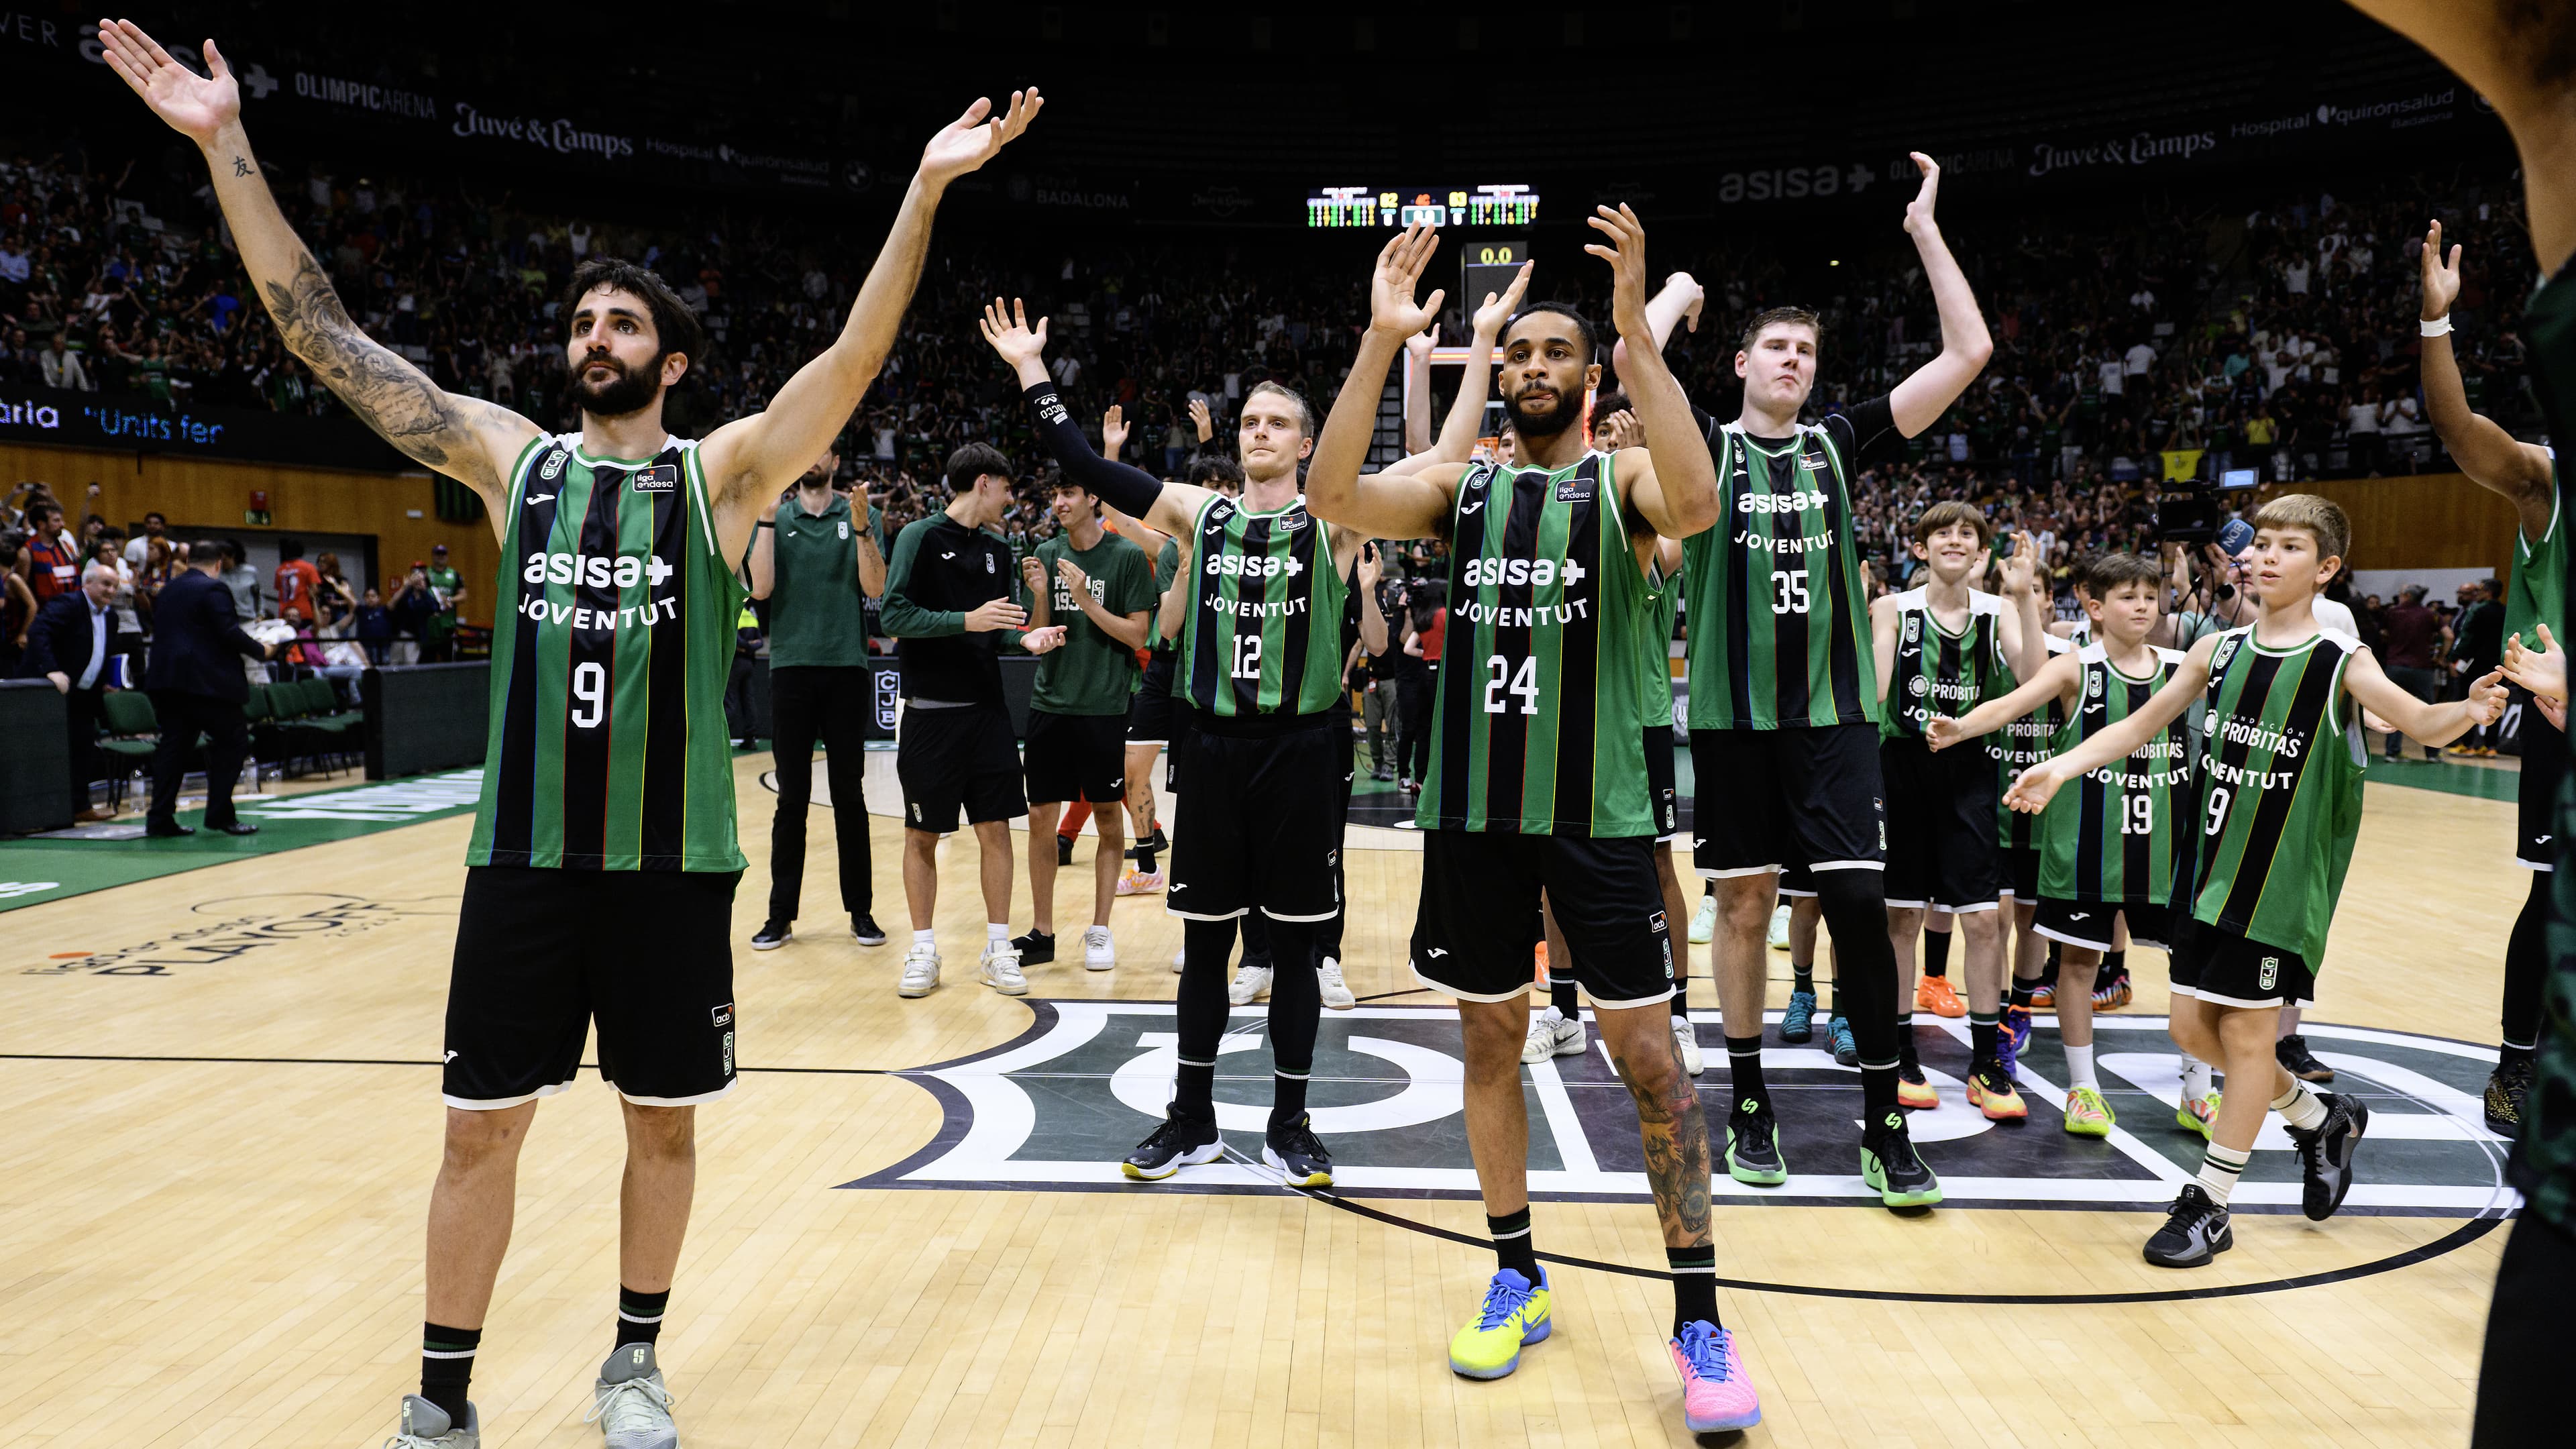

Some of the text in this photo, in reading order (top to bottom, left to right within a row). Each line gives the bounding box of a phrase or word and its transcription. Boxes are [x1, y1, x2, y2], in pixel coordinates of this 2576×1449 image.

[451, 101, 634, 160] Juvé & Camps
[2231, 113, 2311, 139] Hospital
[645, 136, 714, 161] Hospital
[2029, 130, 2216, 176] Juvé & Camps
[233, 156, 255, 178] 友
[1036, 189, 1130, 210] BADALONA
[1481, 247, 1512, 266] 0.0
[180, 414, 224, 444] fer
[637, 474, 654, 483] liga
[637, 480, 674, 488] endesa
[1559, 486, 1574, 494] liga
[1559, 491, 1591, 499] endesa
[1734, 529, 1834, 553] JOVENTUT
[2222, 522, 2246, 547] BDN
[1054, 592, 1083, 611] 193
[1770, 570, 1811, 614] 35
[518, 593, 676, 630] JOVENTUT
[1205, 593, 1306, 618] JOVENTUT
[1454, 598, 1587, 627] JOVENTUT
[1230, 634, 1263, 679] 12
[572, 661, 605, 729] 9
[1484, 655, 1540, 715] 24
[1931, 683, 1980, 700] PROBITA
[2006, 723, 2058, 737] PROBITA
[2220, 720, 2302, 758] PROBITAS
[2131, 742, 2184, 759] ROBITAS
[2086, 766, 2189, 789] JOVENTUT
[2121, 794, 2153, 835] 19
[2205, 786, 2231, 836] 9
[1654, 920, 1665, 930] acb
[91, 903, 395, 977] PLAYOFF
[716, 1013, 730, 1024] acb
